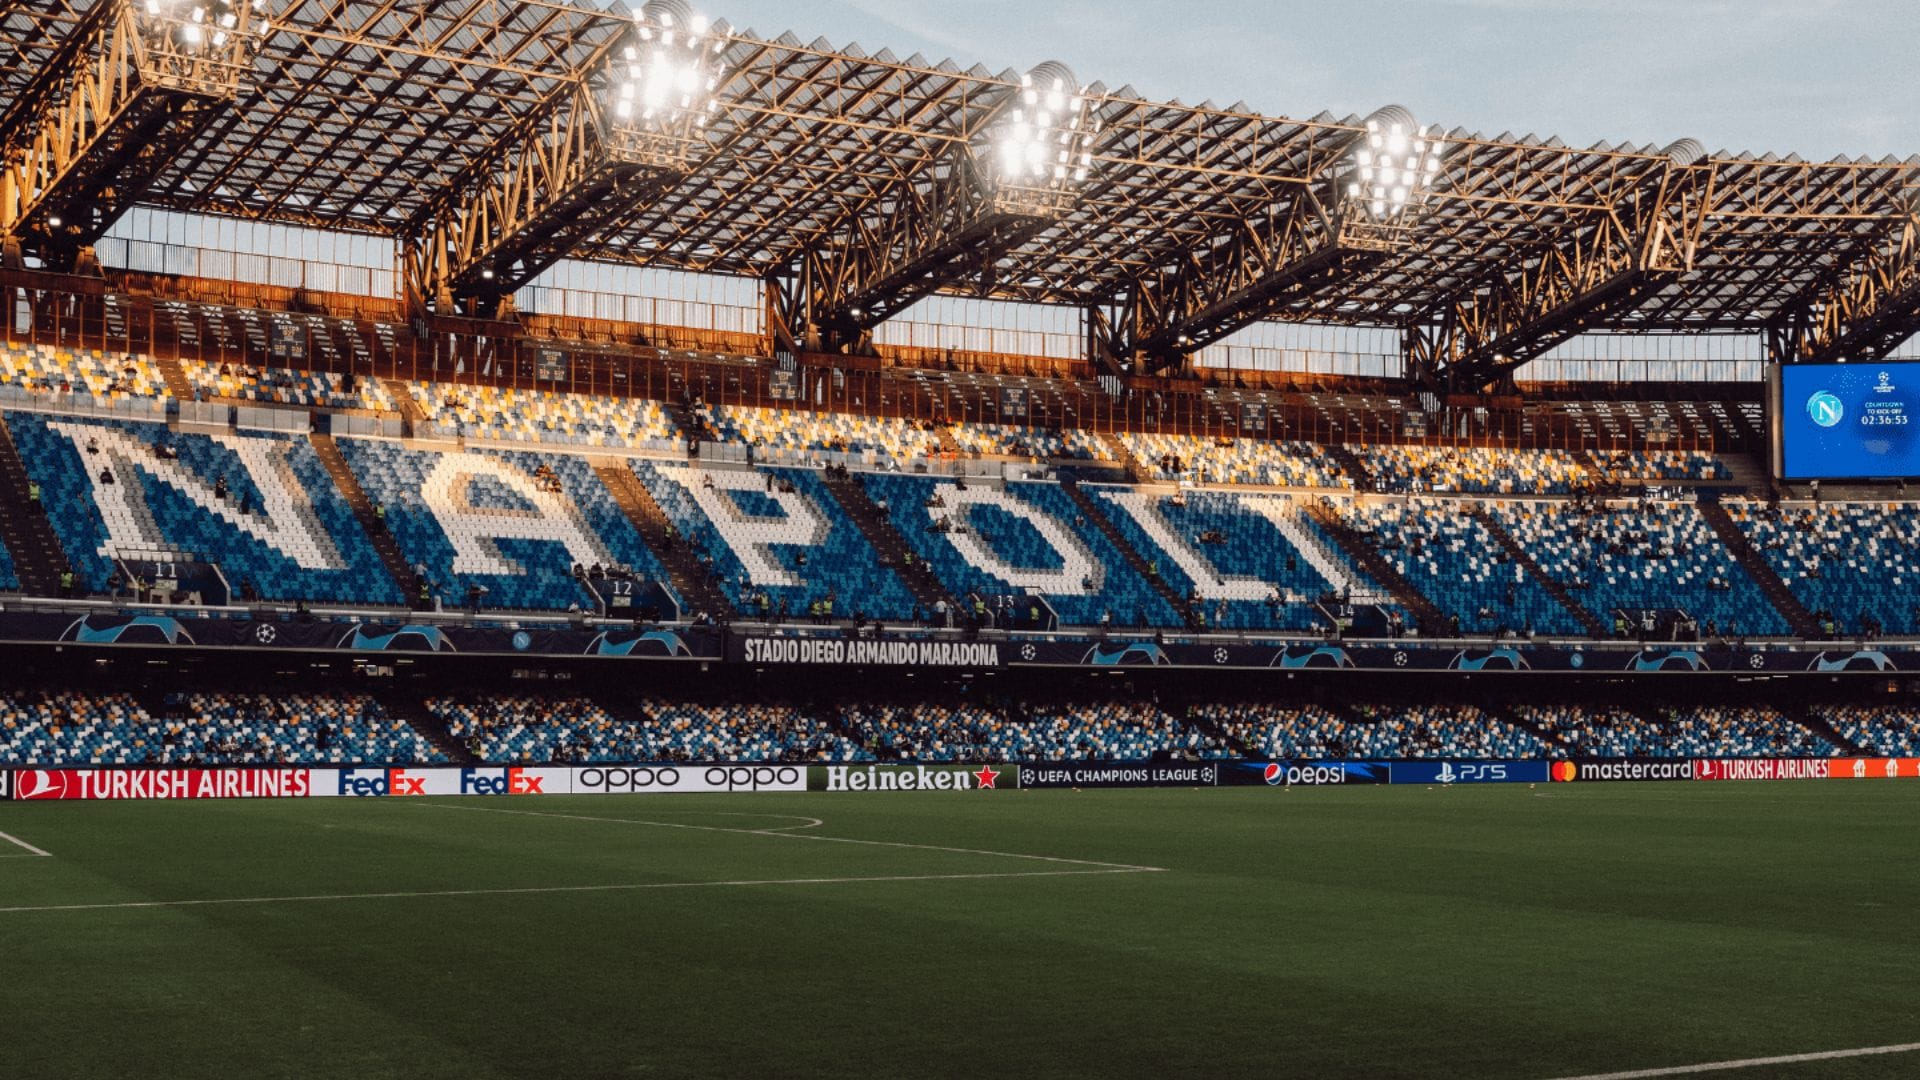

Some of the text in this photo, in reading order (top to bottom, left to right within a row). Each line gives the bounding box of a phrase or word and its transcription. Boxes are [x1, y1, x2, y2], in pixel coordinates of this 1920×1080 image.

[1861, 416, 1908, 424] 02:36:53
[155, 562, 177, 577] 11
[613, 581, 632, 595] 12
[1340, 604, 1354, 617] 14
[745, 639, 998, 666] STADIO DIEGO ARMANDO MARADONA
[705, 766, 799, 791] oppo
[826, 765, 971, 790] Heineken
[1038, 769, 1198, 783] UEFA CHAMPIONS LEAGUE
[1287, 763, 1345, 783] pepsi
[1460, 765, 1506, 779] PS5
[1582, 760, 1691, 779] mastercard
[1721, 759, 1827, 779] TURKISH AIRLINES
[77, 769, 306, 799] TURKISH AIRLINES
[338, 769, 425, 796] FedEx
[461, 767, 543, 795] FedEx
[580, 767, 679, 792] oppo
